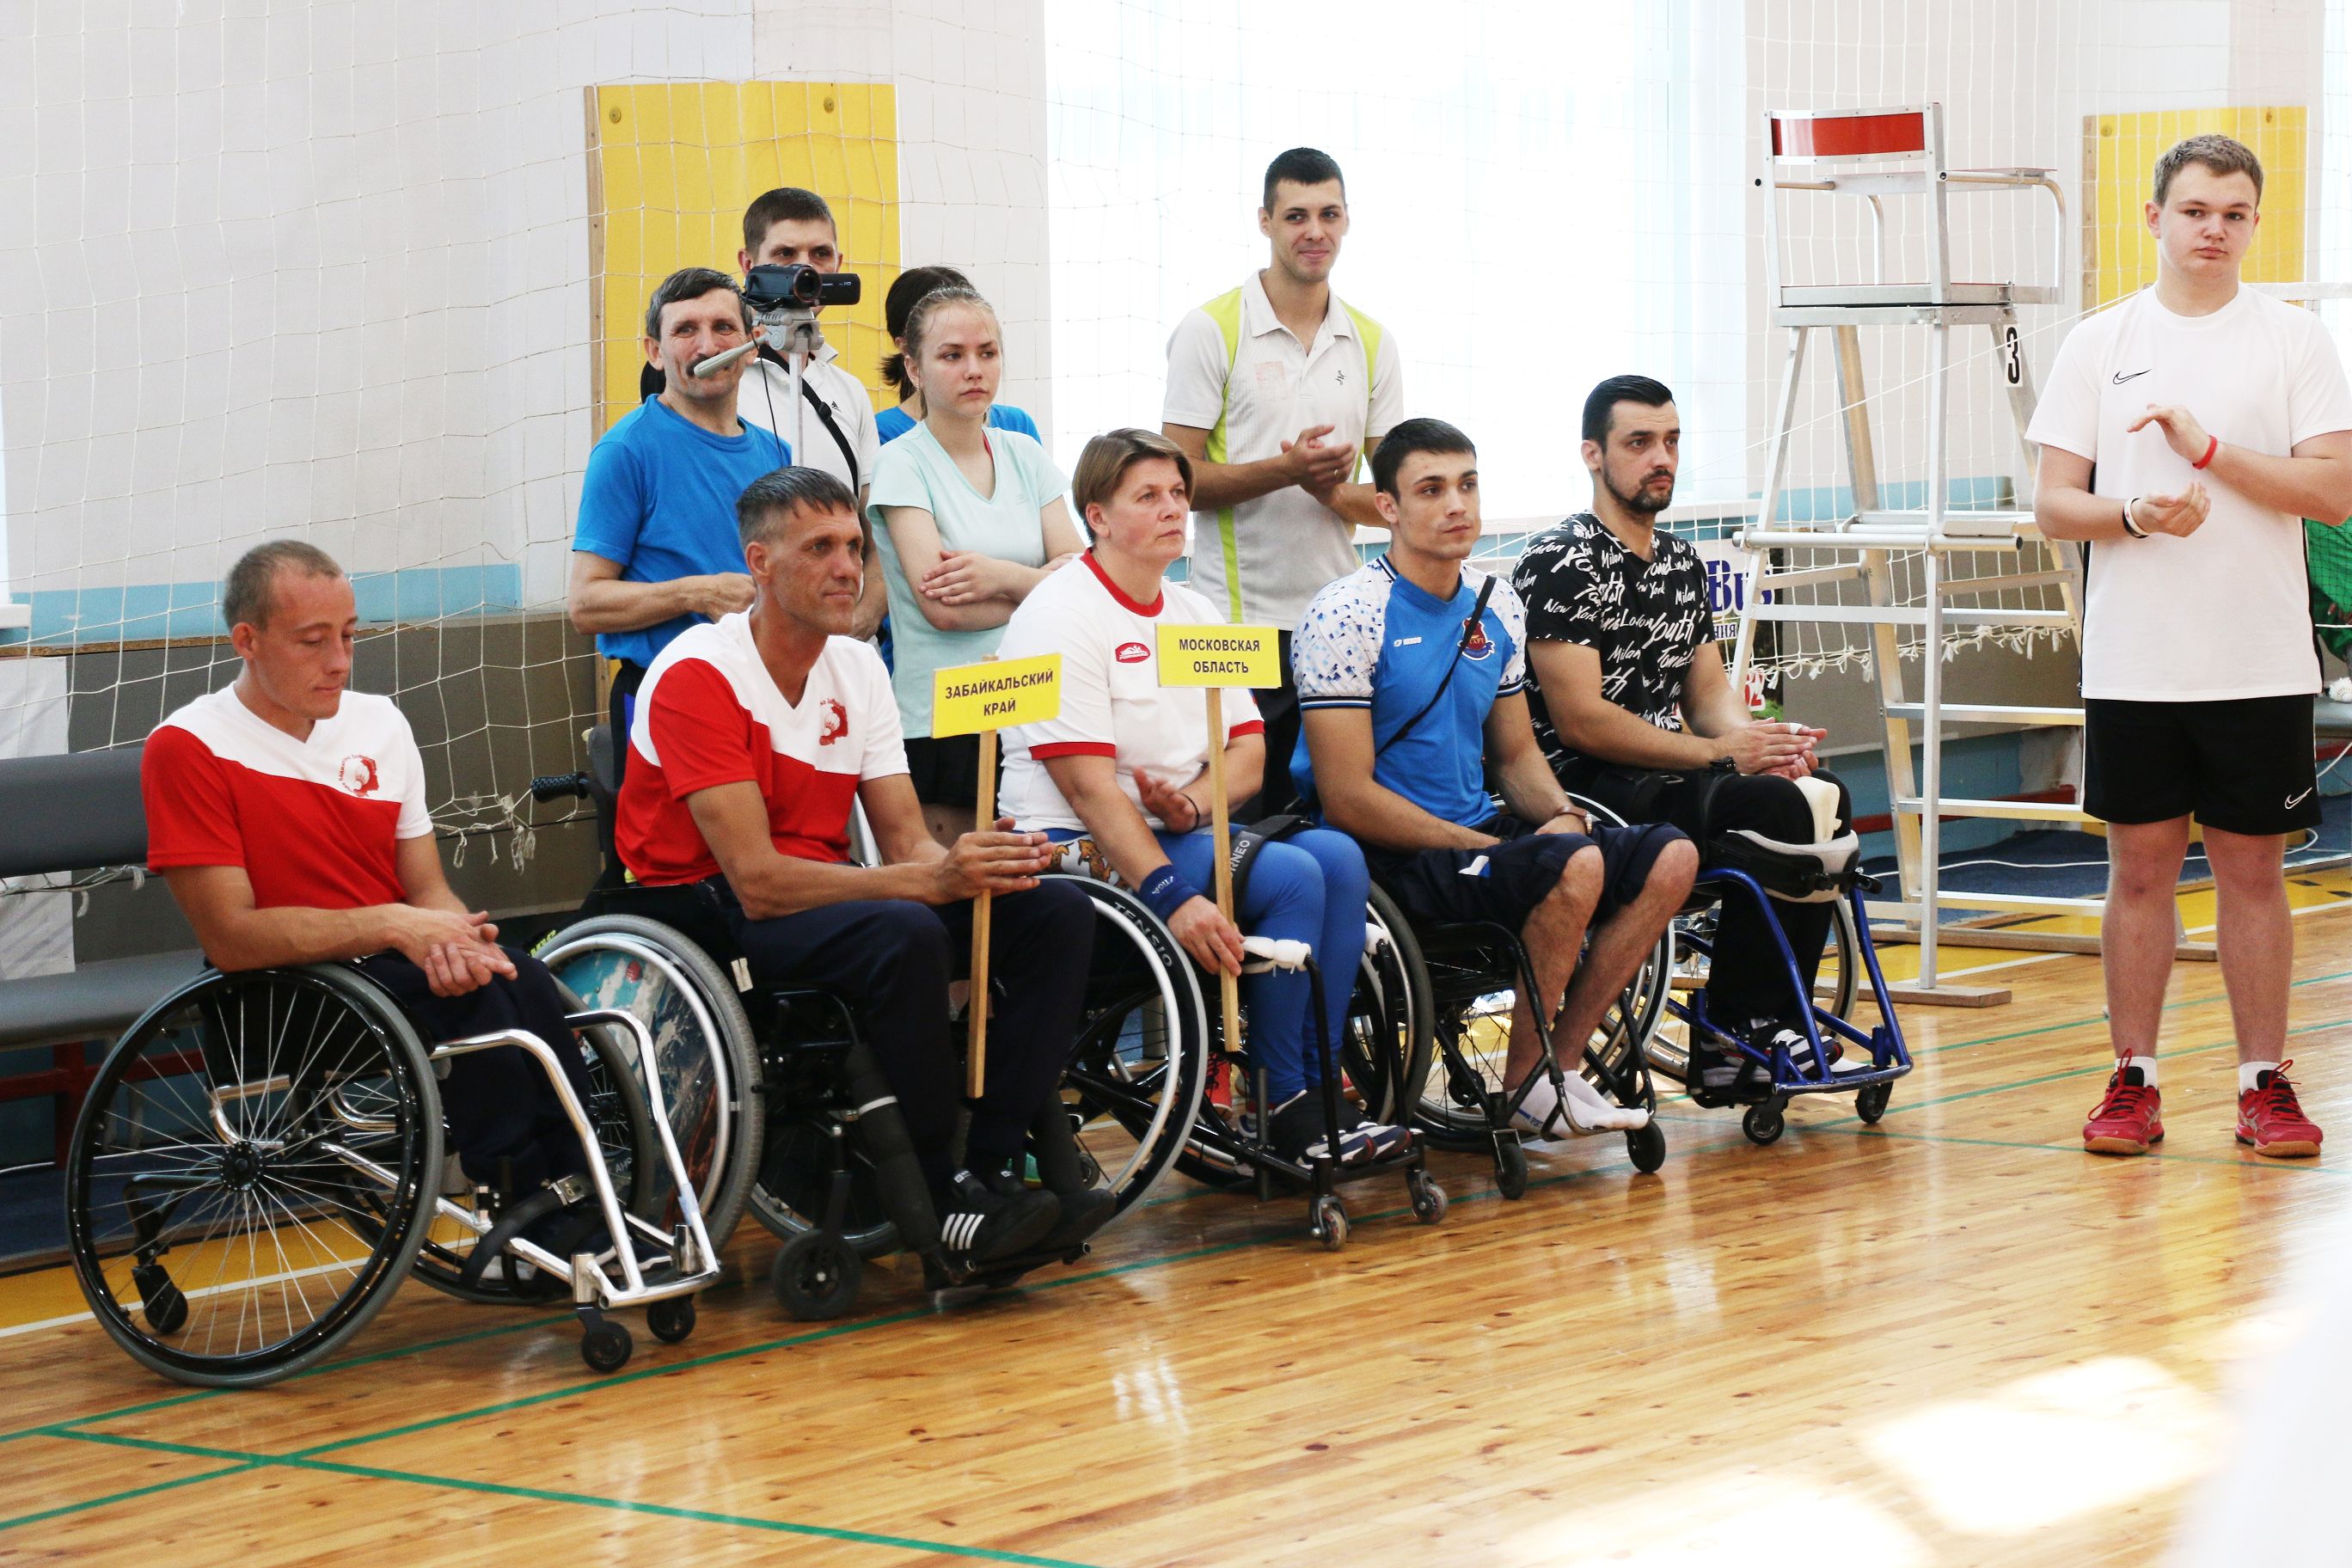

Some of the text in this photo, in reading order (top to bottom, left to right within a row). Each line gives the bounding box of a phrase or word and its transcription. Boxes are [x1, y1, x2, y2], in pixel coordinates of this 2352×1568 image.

[2006, 327, 2020, 384] 3
[1543, 598, 1601, 622] New York
[1641, 609, 1694, 650] Youth
[1179, 639, 1260, 652] МОСКОВСКАЯ
[1607, 640, 1641, 664] Milan
[1193, 660, 1249, 673] ОБЛАСТЬ
[945, 668, 1054, 700] ЗАБАЙКАЛЬСКИЙ
[983, 697, 1016, 716] КРАЙ
